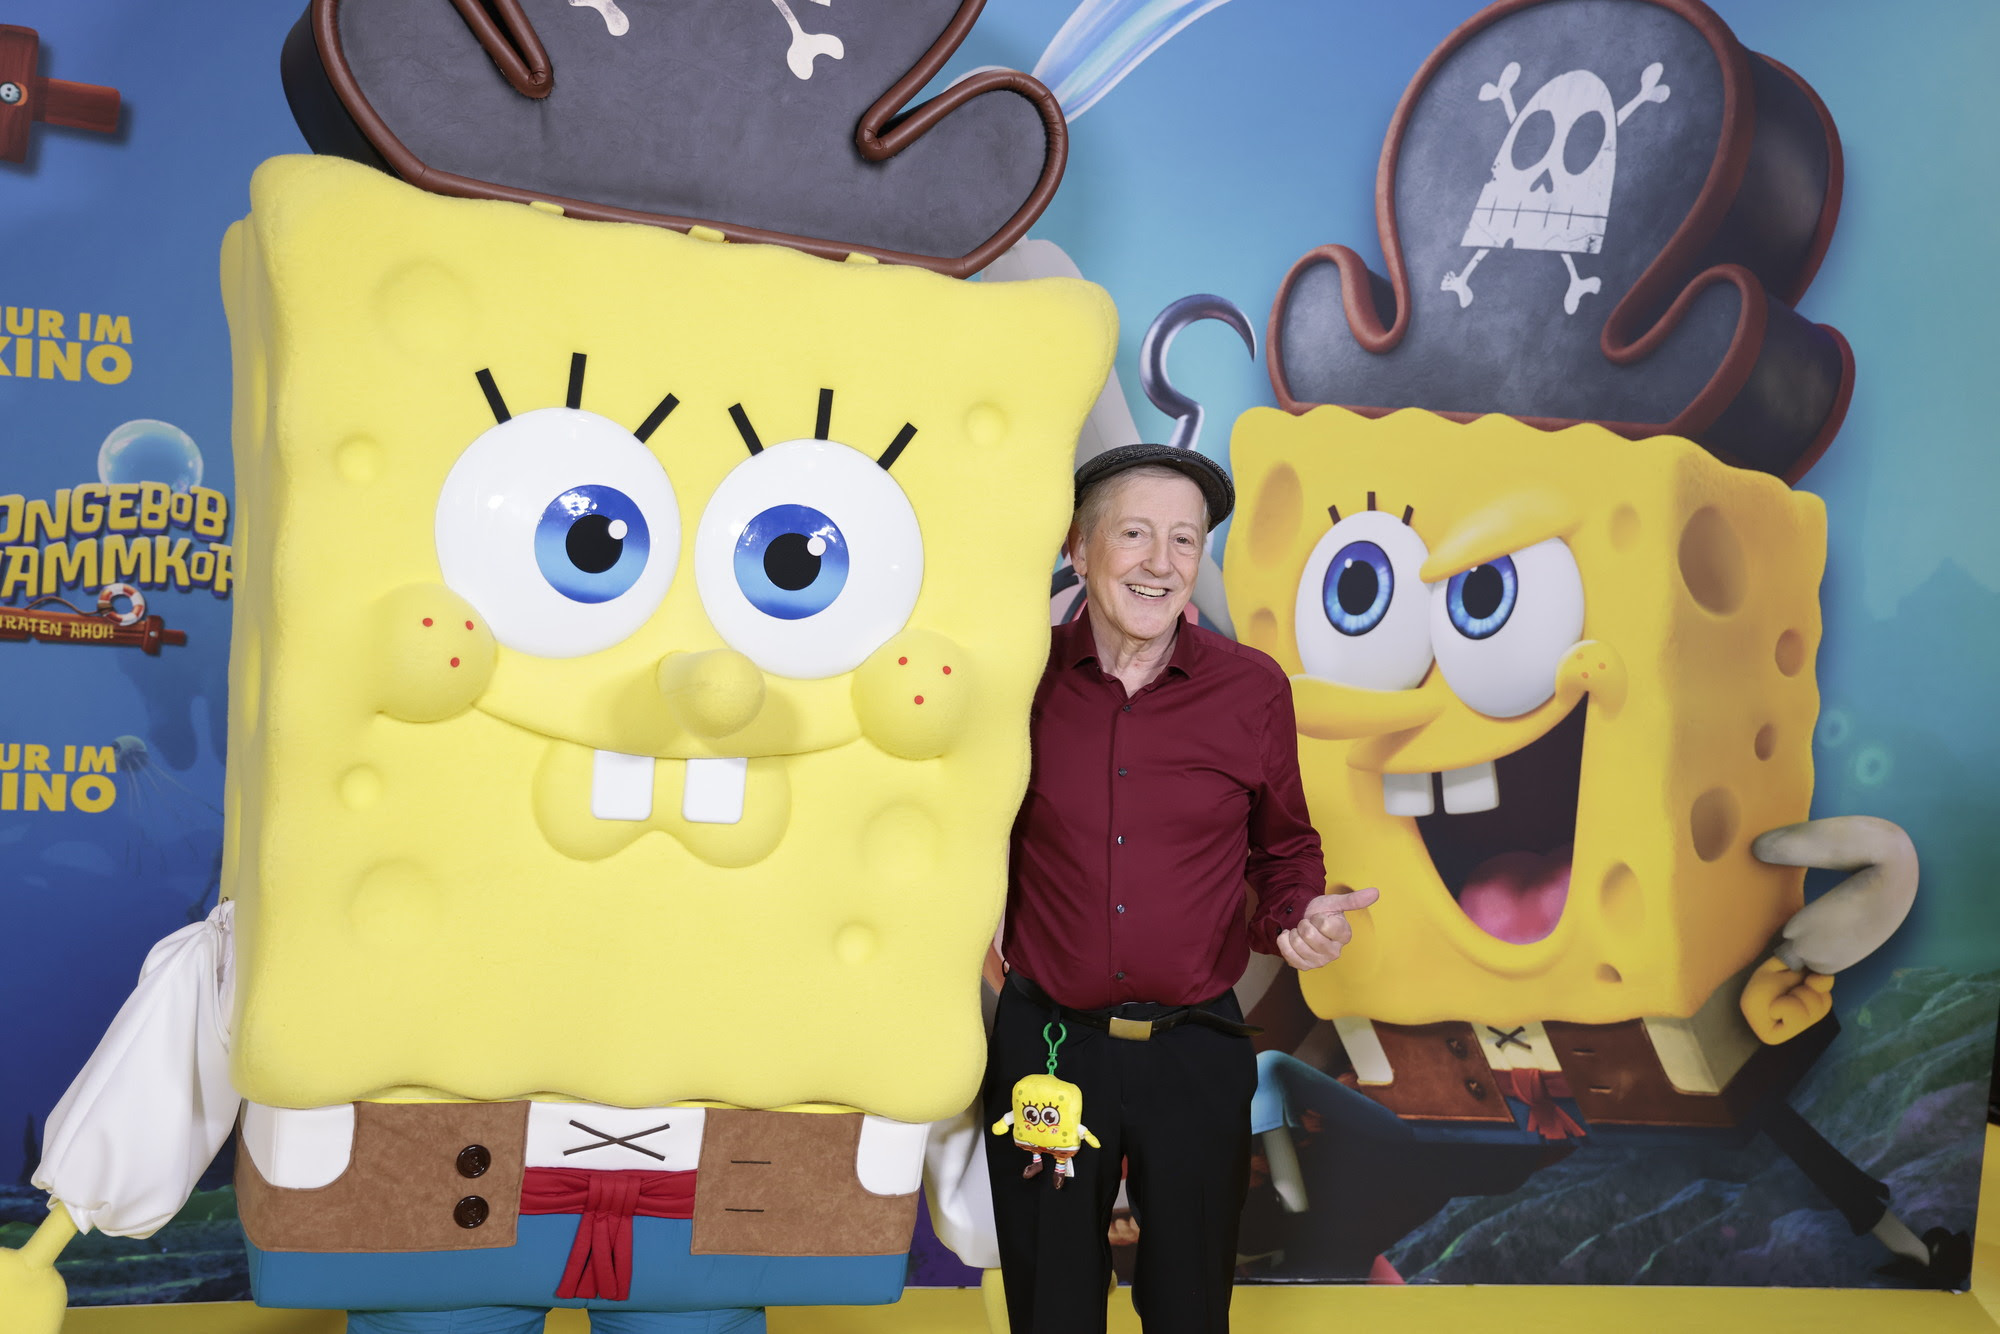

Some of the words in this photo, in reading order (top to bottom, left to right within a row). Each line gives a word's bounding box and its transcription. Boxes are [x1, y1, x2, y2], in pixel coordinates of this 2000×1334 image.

[78, 312, 133, 345] IM
[69, 621, 114, 639] AHOI!
[63, 744, 117, 774] IM
